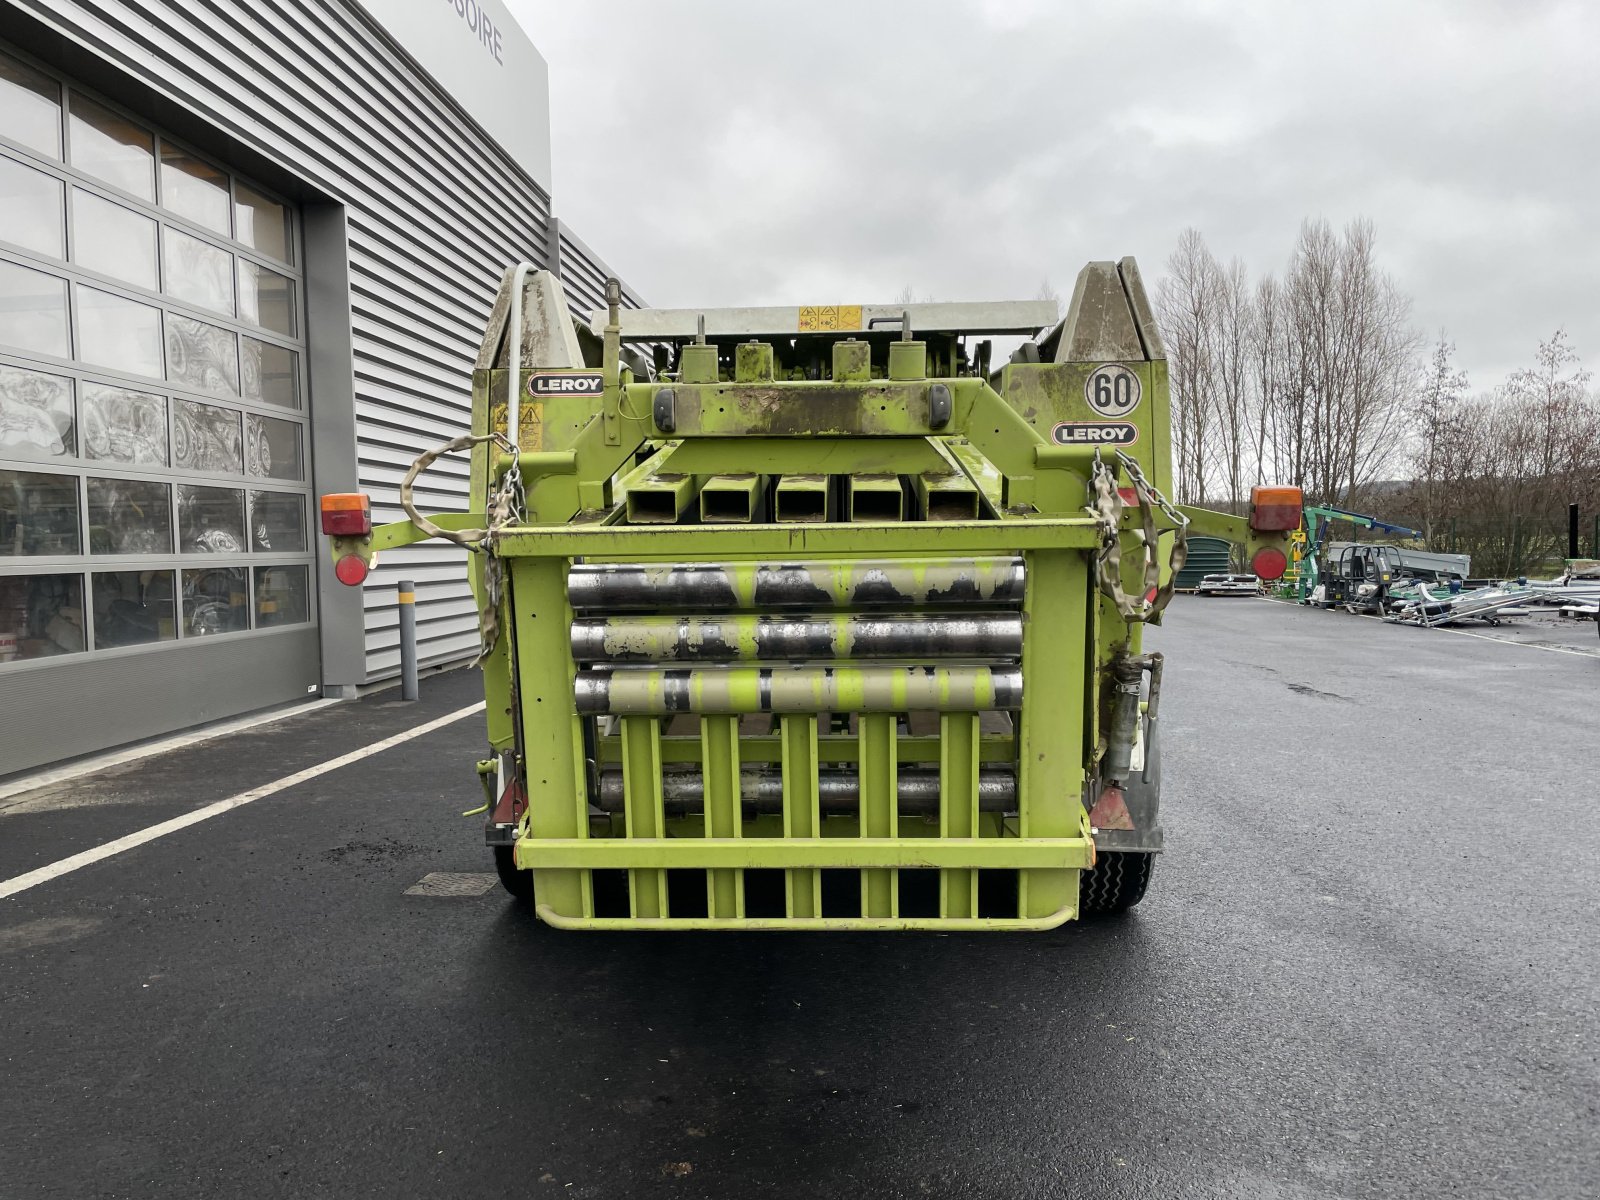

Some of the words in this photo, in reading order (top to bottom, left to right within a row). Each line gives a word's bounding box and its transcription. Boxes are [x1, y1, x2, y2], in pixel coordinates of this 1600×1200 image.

[447, 0, 503, 67] OIRE
[537, 378, 601, 391] LEROY
[1094, 373, 1131, 408] 60
[1062, 427, 1129, 441] LEROY
